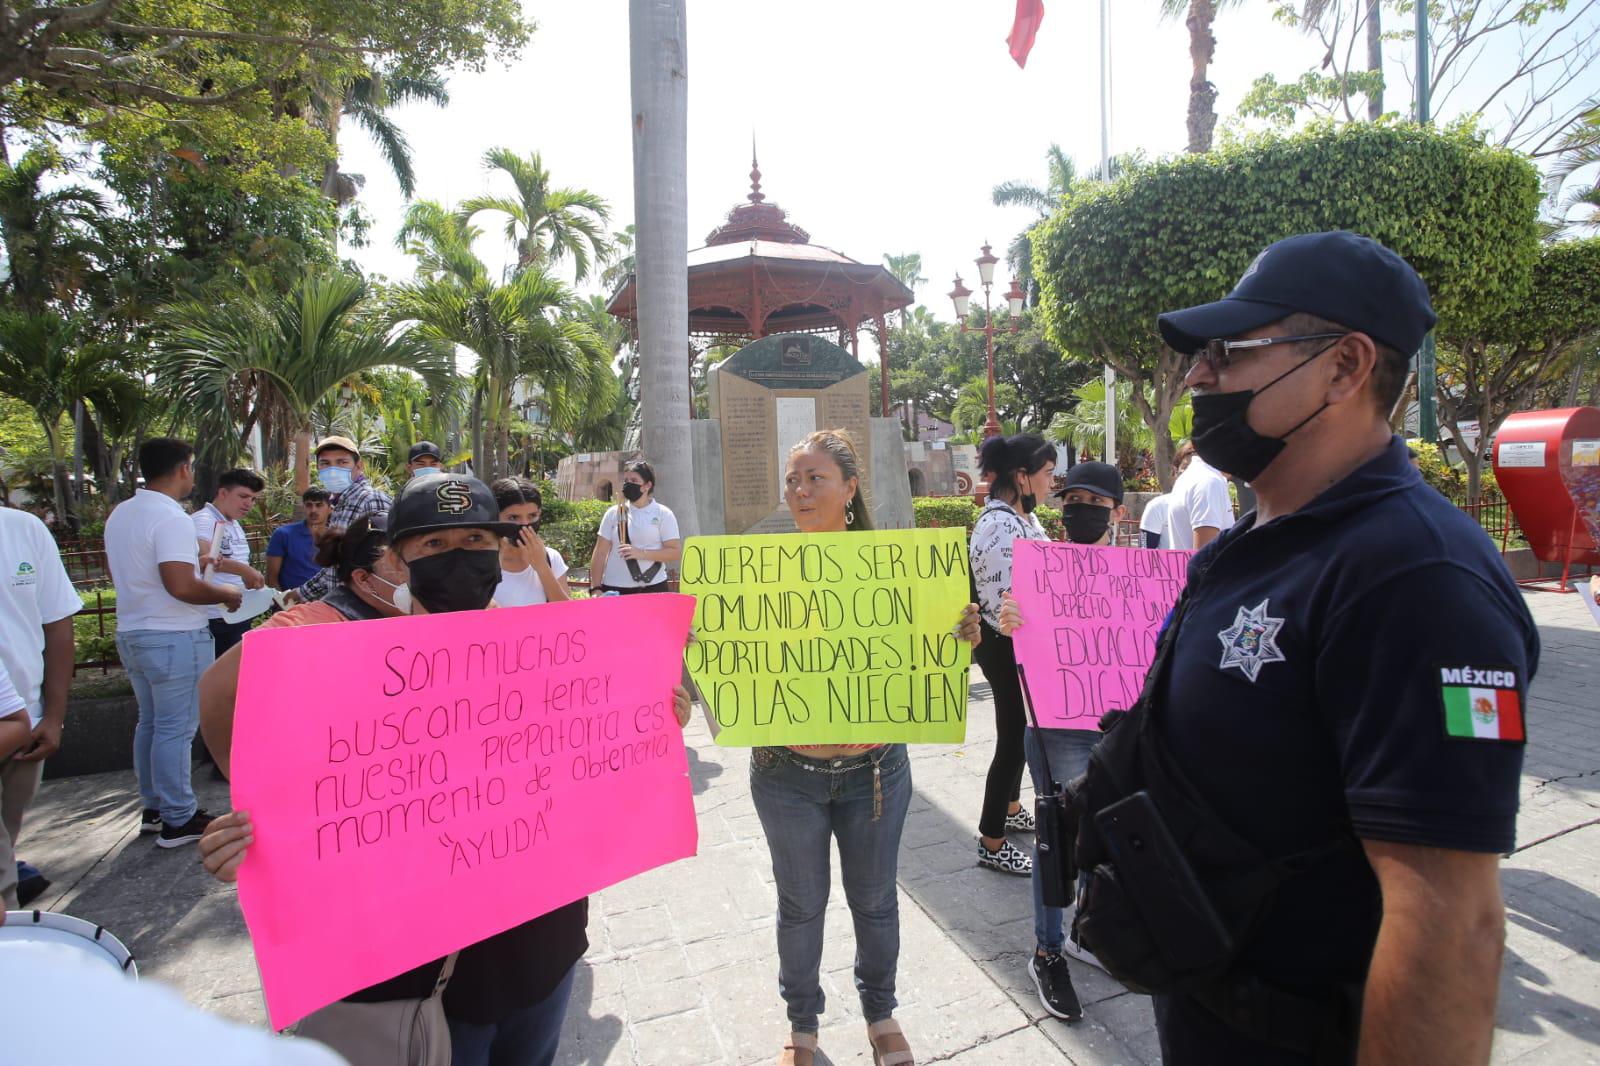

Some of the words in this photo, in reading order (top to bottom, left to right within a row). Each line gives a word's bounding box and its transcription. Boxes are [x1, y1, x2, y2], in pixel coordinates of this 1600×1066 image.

[681, 544, 844, 585] QUEREMOS
[855, 543, 907, 582] SER
[916, 541, 966, 579] UNA
[1034, 569, 1055, 594] LA
[1108, 574, 1146, 601] PARA
[690, 588, 844, 633] OMUNIDAD
[853, 586, 913, 628] CON
[1123, 599, 1135, 621] A
[1054, 622, 1159, 667] EDUCACIÓ
[543, 673, 613, 715] tener
[1440, 665, 1516, 688] MÉXICO
[753, 677, 811, 726] LAS
[315, 750, 449, 817] nuestra
[634, 701, 666, 734] es
[317, 775, 506, 861] momento
[525, 762, 552, 796] de
